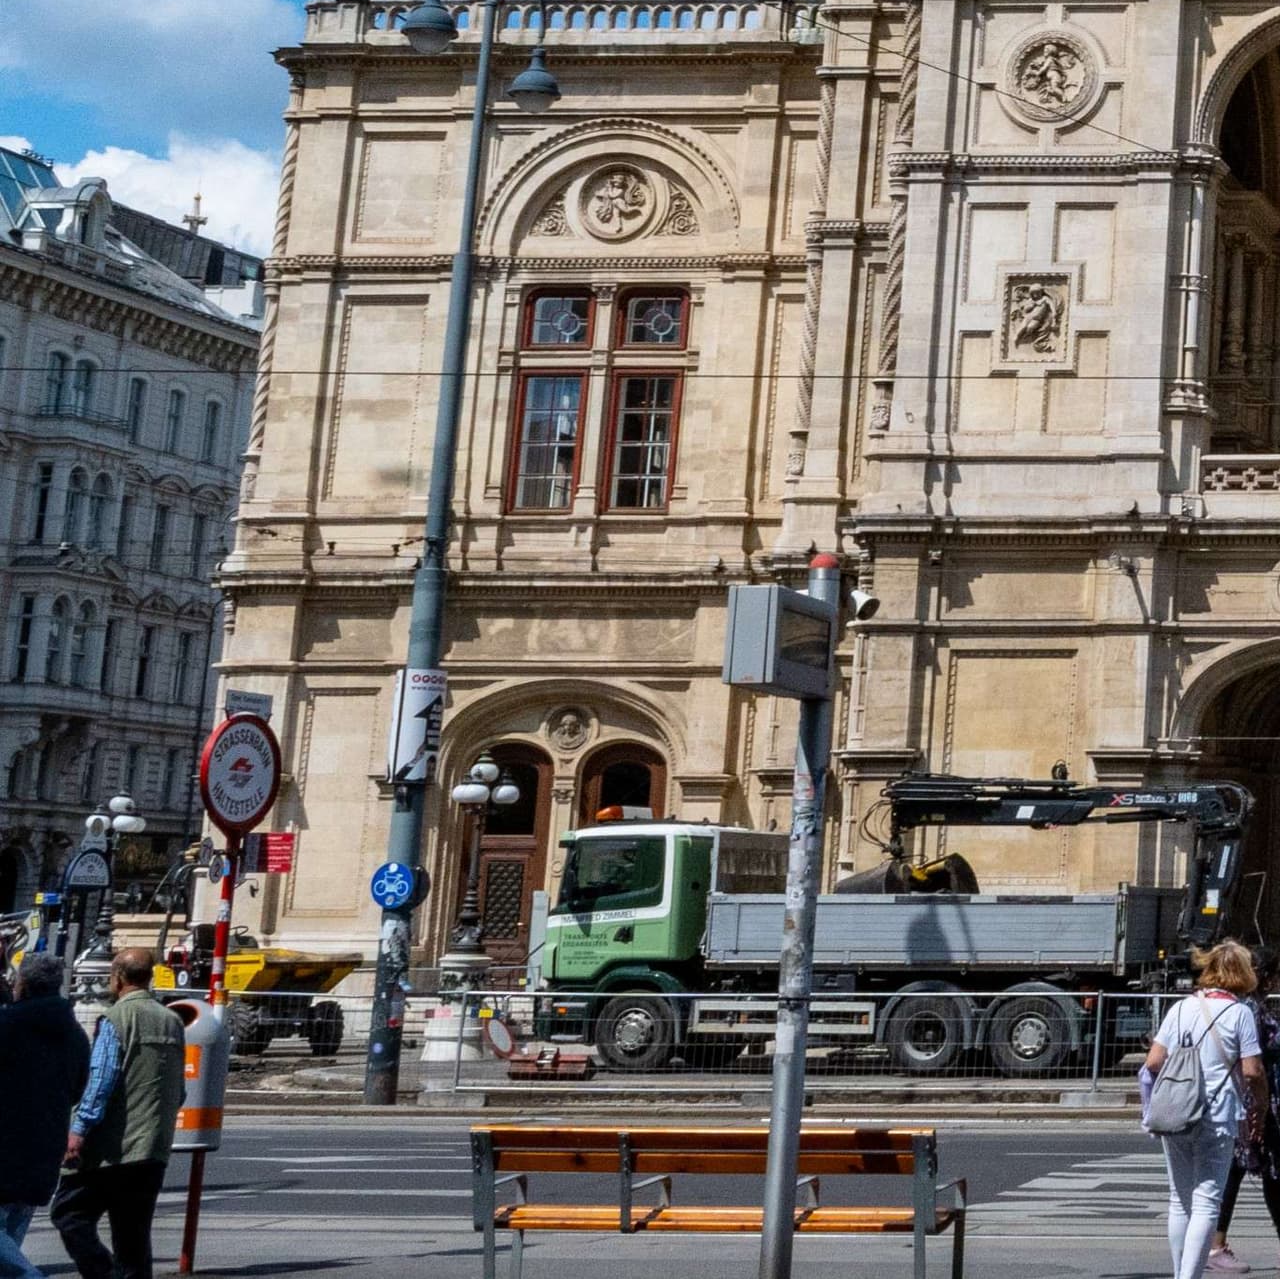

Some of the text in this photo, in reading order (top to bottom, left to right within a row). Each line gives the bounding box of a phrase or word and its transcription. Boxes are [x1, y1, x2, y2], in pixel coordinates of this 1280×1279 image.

[214, 728, 272, 768] STRASSENBAHN
[212, 781, 265, 816] HALTESTELLE
[1110, 793, 1134, 806] XS
